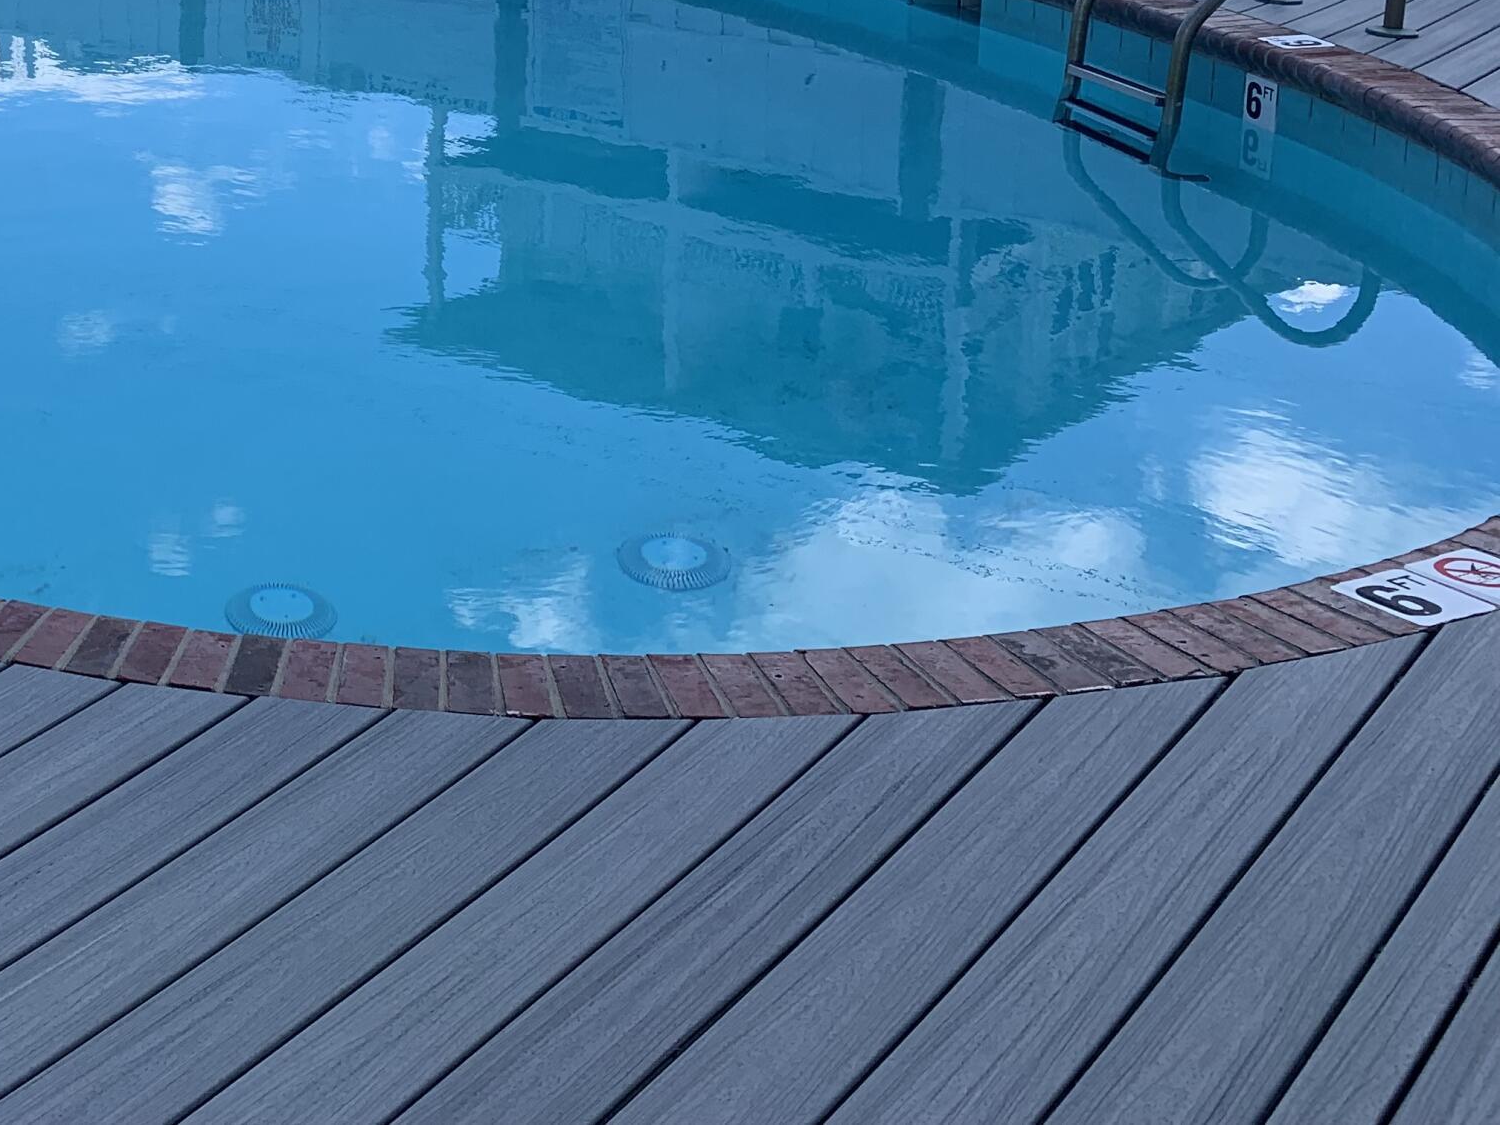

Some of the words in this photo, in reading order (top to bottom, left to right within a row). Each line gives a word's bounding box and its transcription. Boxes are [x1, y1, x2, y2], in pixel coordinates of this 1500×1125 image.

[1246, 81, 1262, 120] 6
[1263, 86, 1275, 101] FT
[1386, 575, 1426, 590] FT
[1355, 585, 1442, 616] 6
